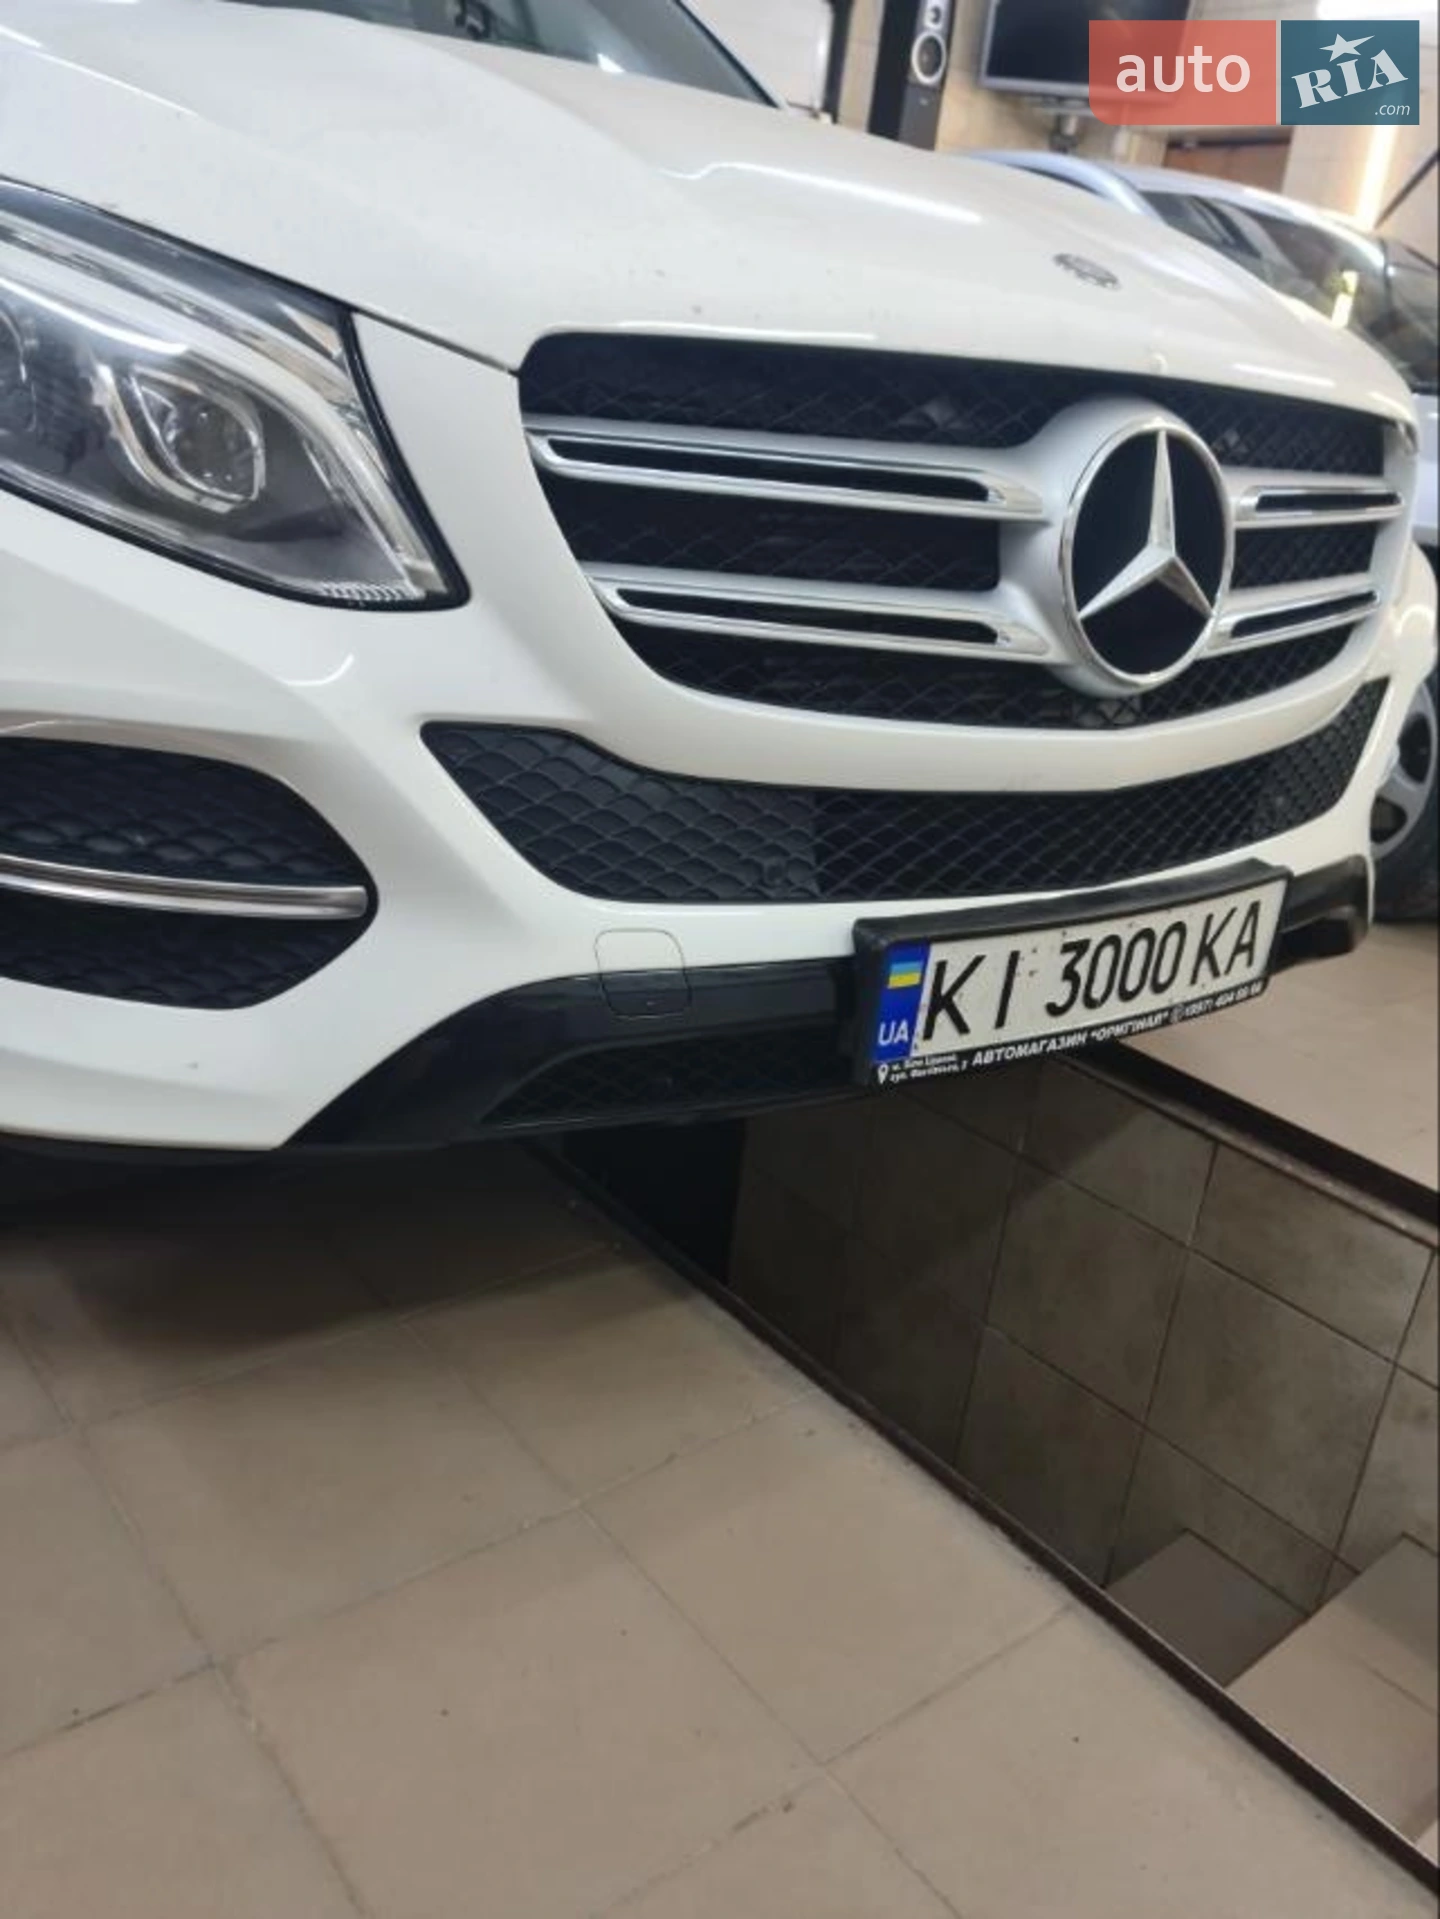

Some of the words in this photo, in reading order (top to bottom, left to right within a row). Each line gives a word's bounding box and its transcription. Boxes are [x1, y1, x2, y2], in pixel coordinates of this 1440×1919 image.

[1045, 920, 1187, 1018] 3000
[1190, 899, 1262, 988] KA
[878, 1019, 909, 1047] UA
[971, 1032, 1088, 1067] АВТОМАГАЗИН
